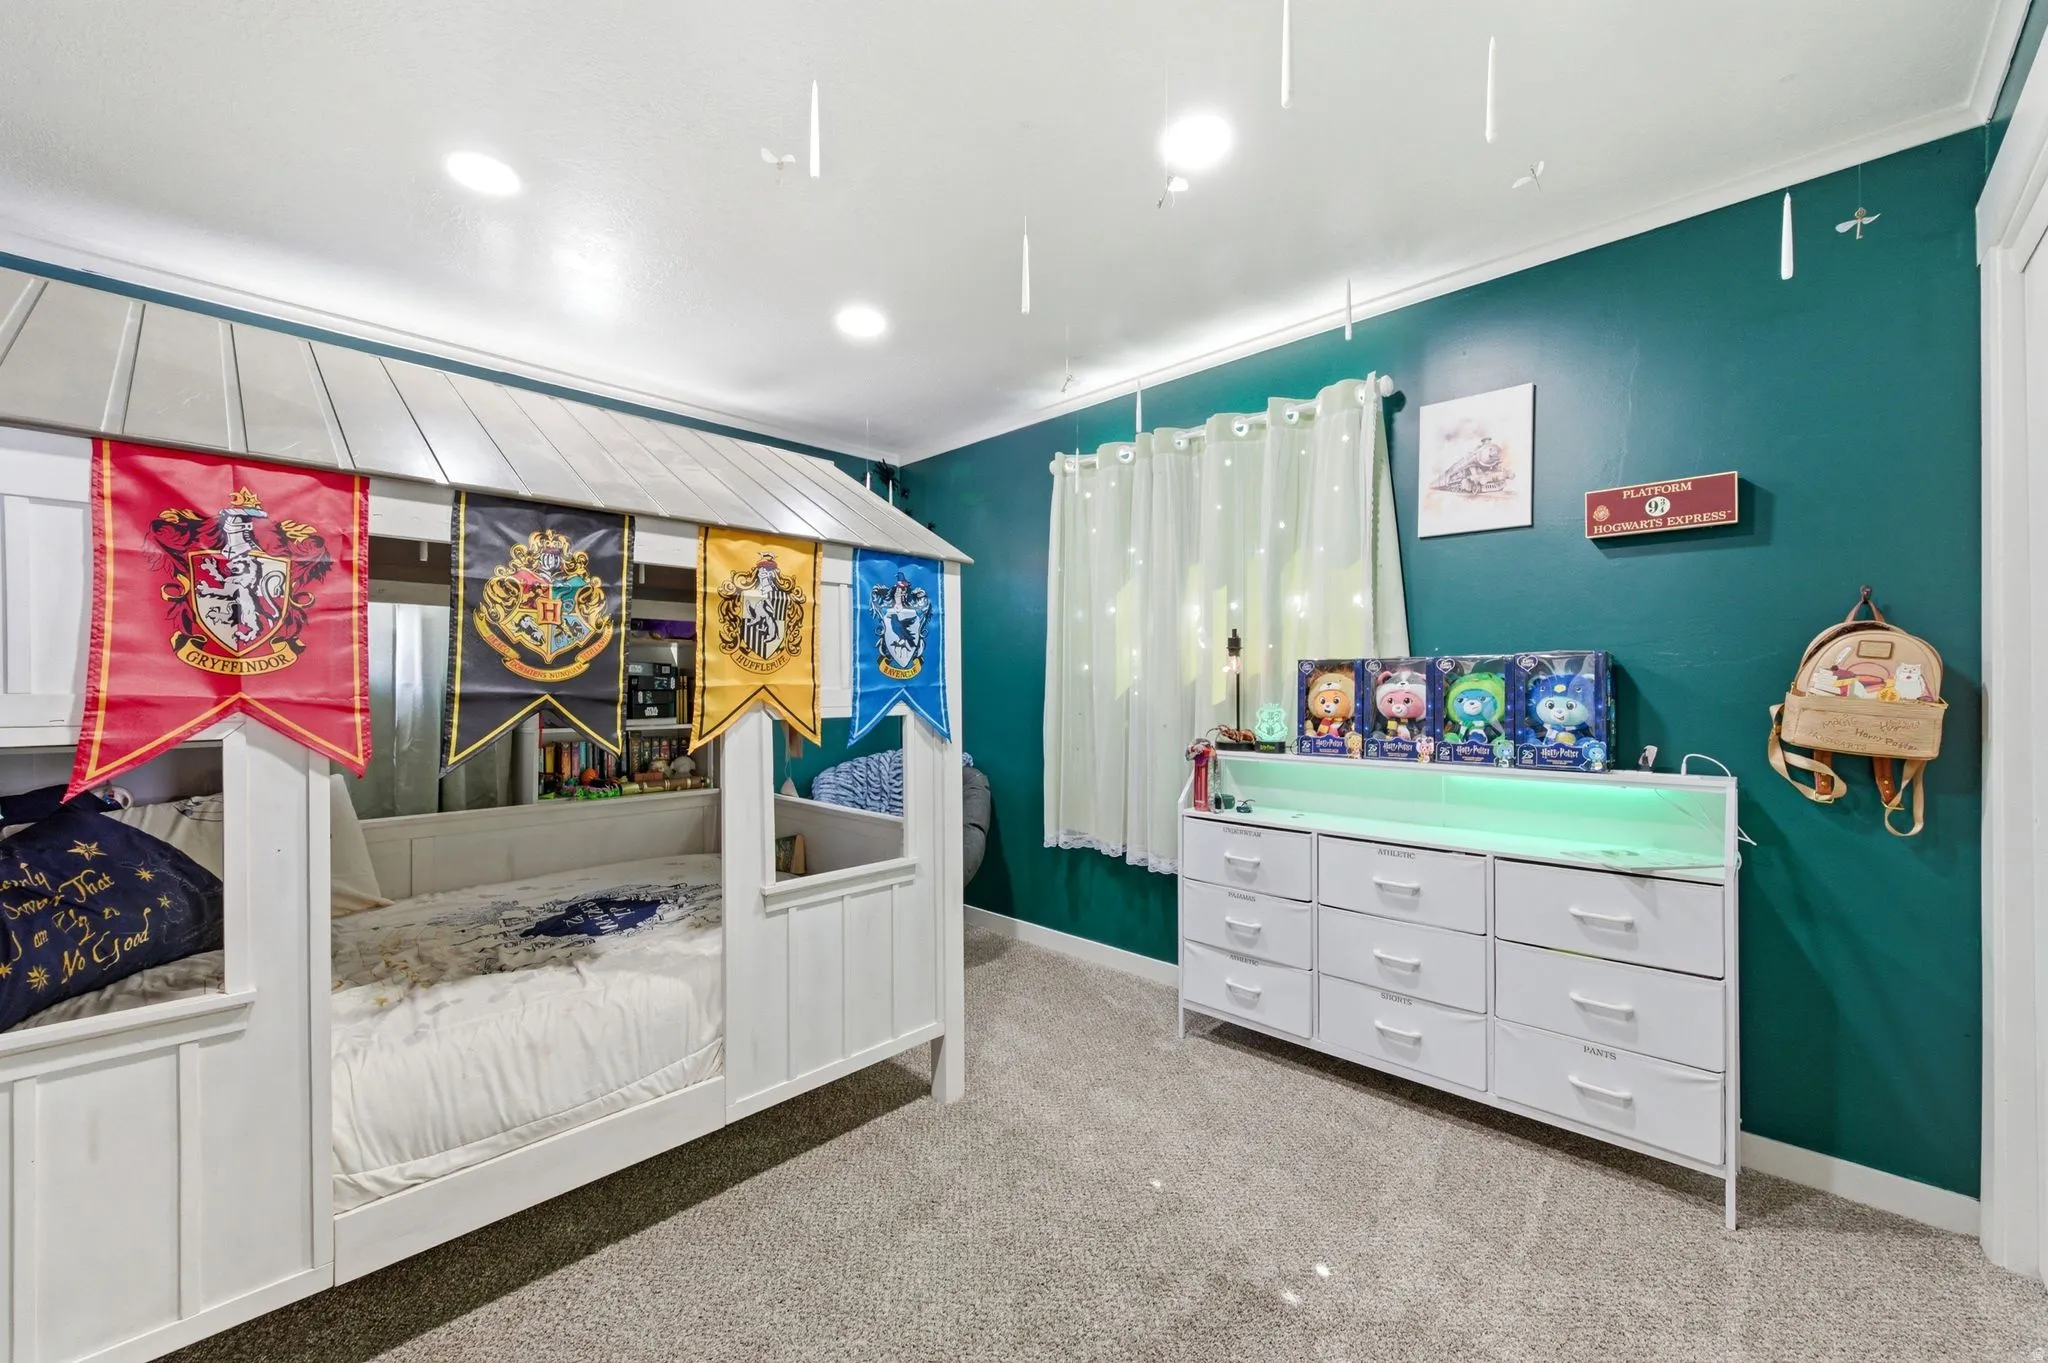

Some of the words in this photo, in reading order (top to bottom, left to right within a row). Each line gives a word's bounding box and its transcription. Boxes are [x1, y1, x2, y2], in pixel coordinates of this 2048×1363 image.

[1623, 481, 1692, 500] PLATFORM
[1593, 517, 1663, 535] HOGWARTS
[1667, 510, 1727, 527] EXPRESS
[541, 602, 558, 622] H
[185, 650, 291, 674] GRYFFINDOR
[736, 654, 787, 672] HUFFLEPUFF
[1855, 728, 1881, 742] Harry
[1885, 737, 1919, 752] Potter
[1560, 747, 1579, 758] Potter
[1377, 848, 1416, 860] ATHLETIC
[58, 868, 115, 903] That
[33, 930, 49, 948] am
[61, 949, 86, 984] No
[92, 906, 152, 971] Good
[1380, 991, 1413, 1006] SHORTS
[1583, 1044, 1617, 1060] PANTS
